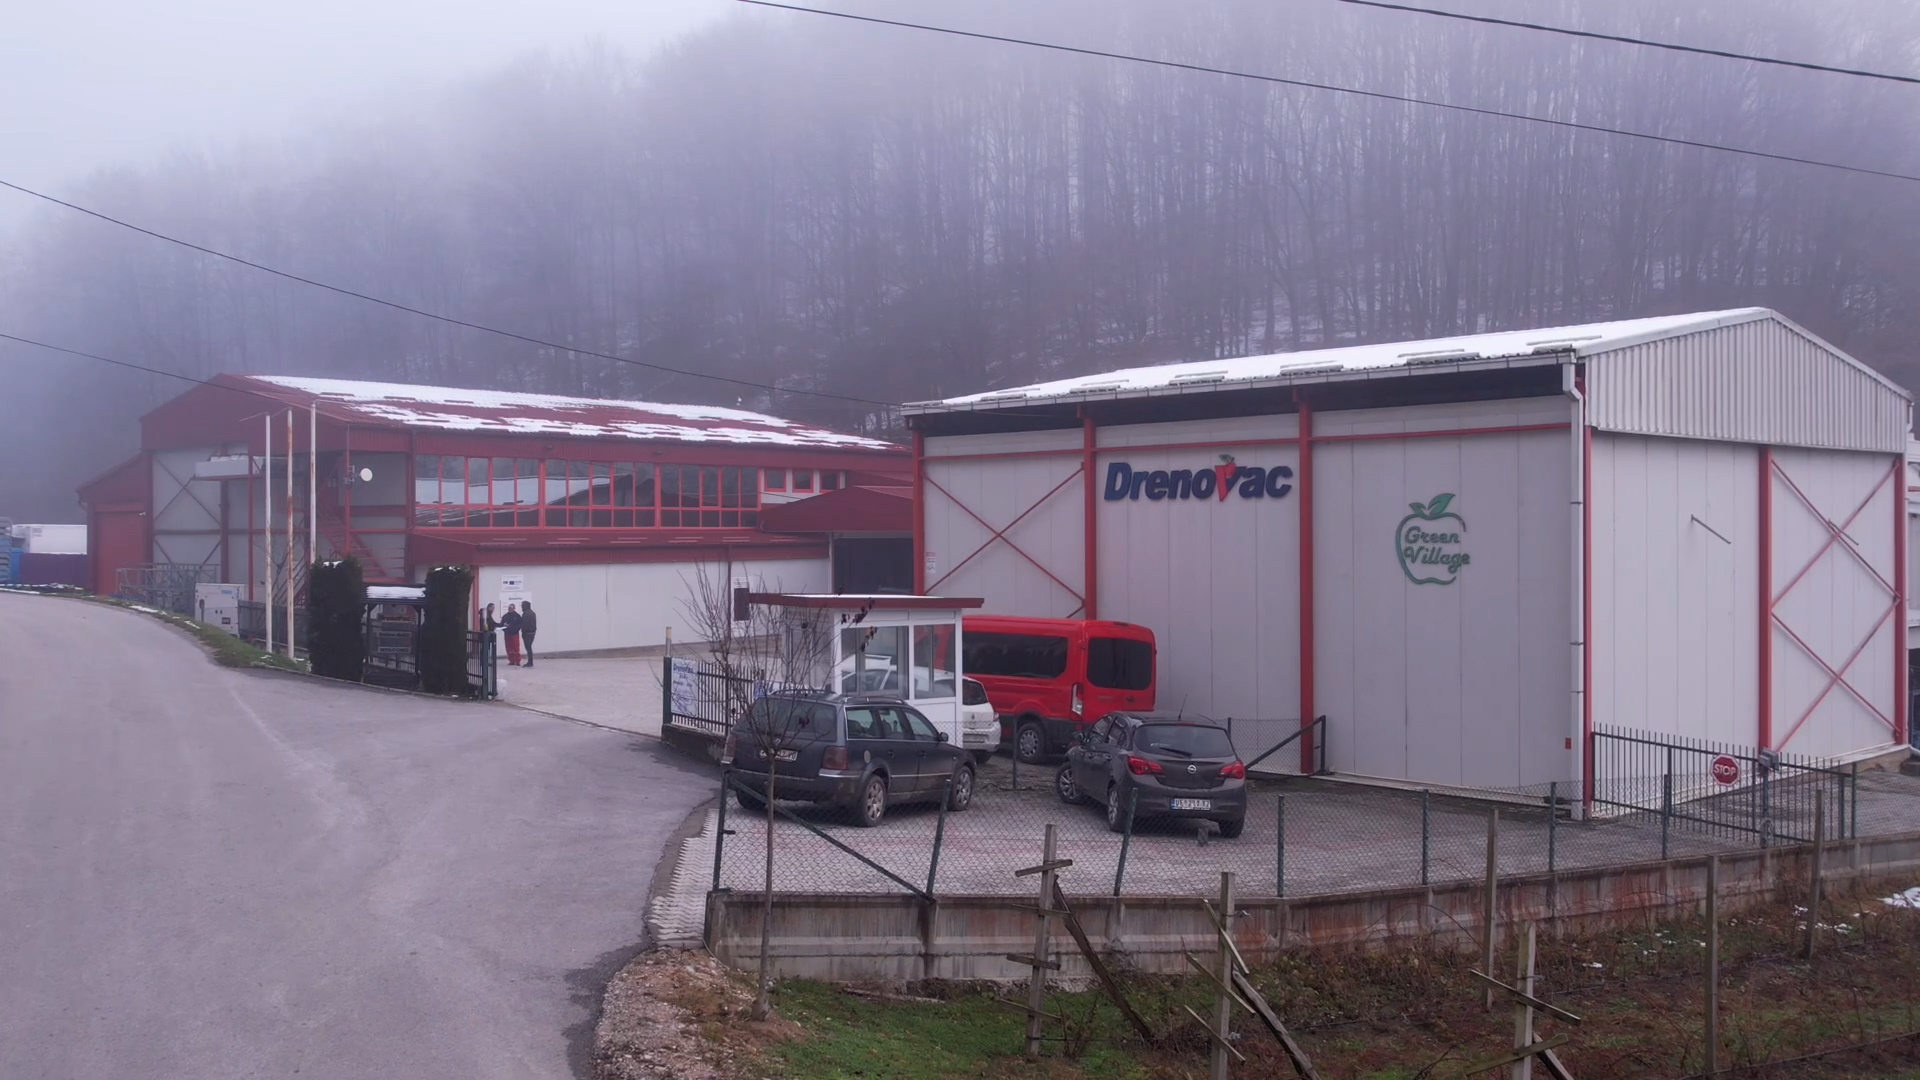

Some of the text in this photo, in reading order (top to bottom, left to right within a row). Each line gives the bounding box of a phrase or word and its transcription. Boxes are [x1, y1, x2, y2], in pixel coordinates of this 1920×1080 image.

[1104, 461, 1294, 502] Drenovac
[1404, 526, 1460, 544] Green
[1403, 545, 1471, 574] Village
[1714, 763, 1737, 776] STOP
